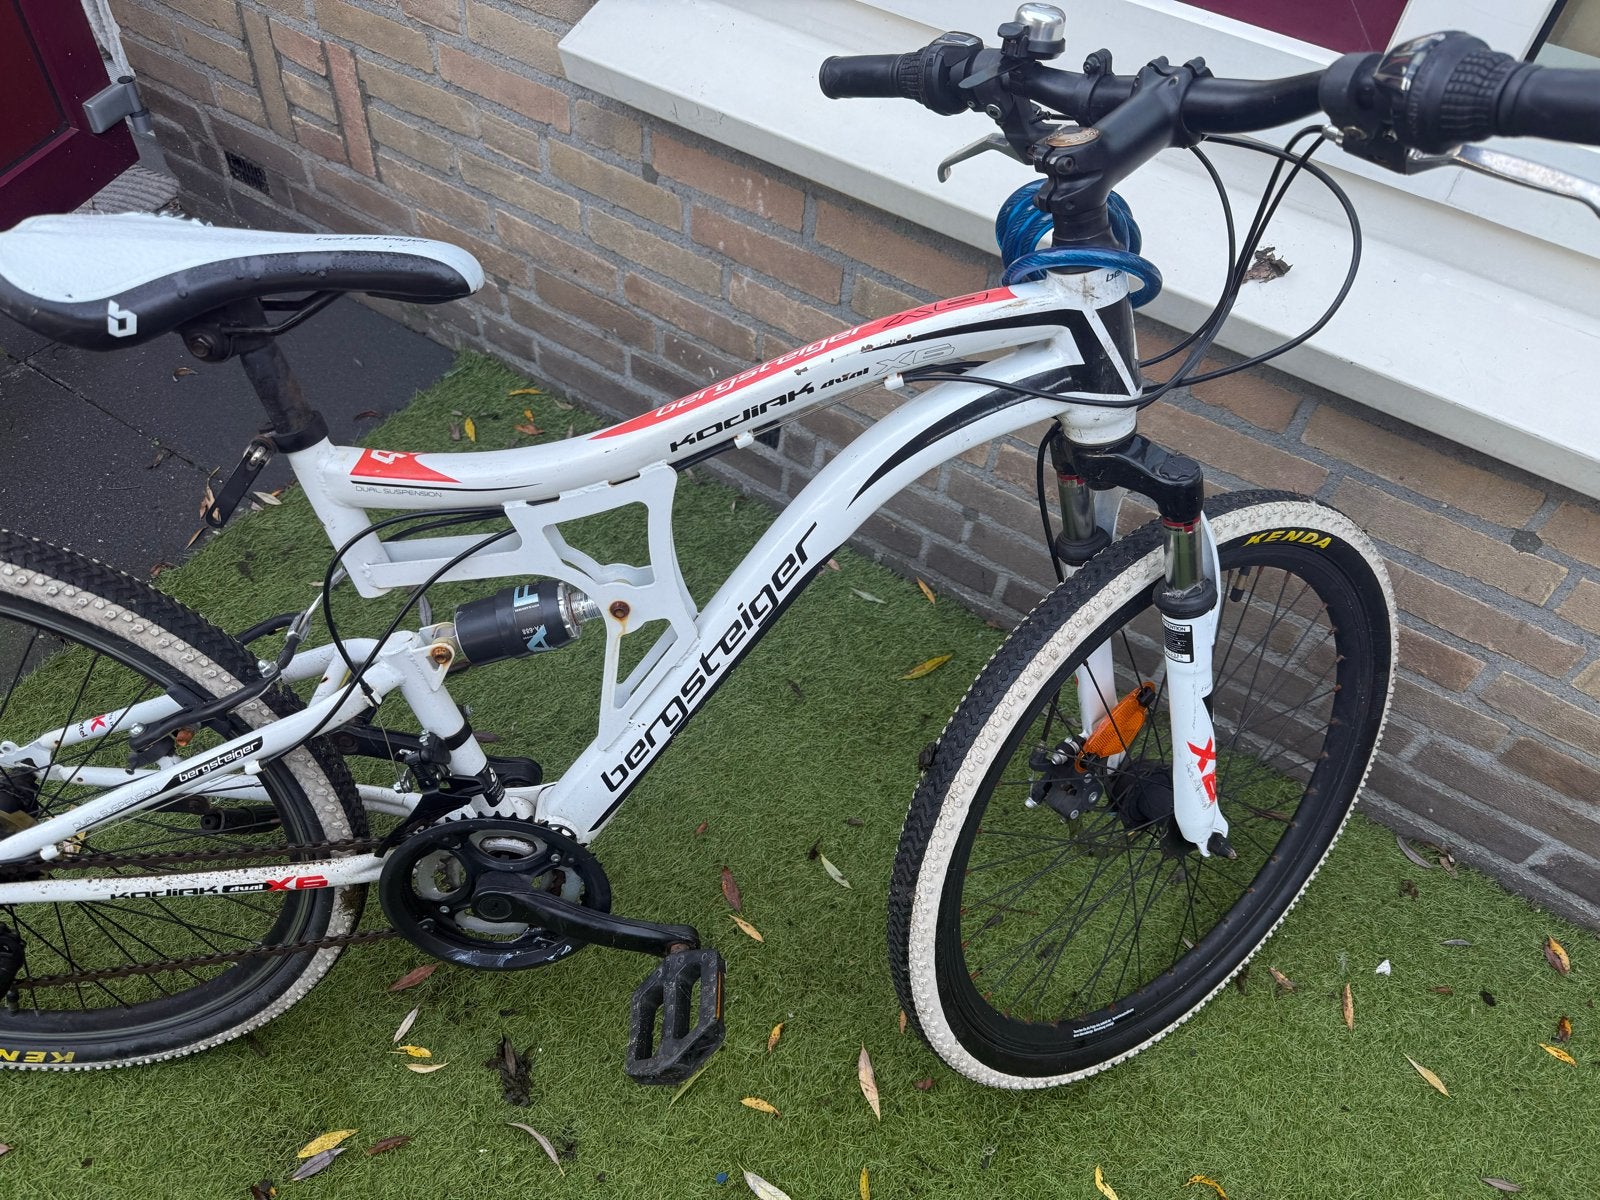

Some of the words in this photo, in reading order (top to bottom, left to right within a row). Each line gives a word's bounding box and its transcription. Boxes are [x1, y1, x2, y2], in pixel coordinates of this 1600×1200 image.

[655, 326, 860, 418] bergsteiger
[355, 485, 382, 494] DUAL
[383, 488, 443, 498] SUSPENSION
[1242, 530, 1332, 549] KENDA
[600, 521, 818, 793] bergsteiger
[178, 741, 259, 783] bergsteiger
[73, 814, 99, 831] DUAL
[100, 785, 161, 818] SUSPENSION
[228, 883, 265, 893] dual
[265, 874, 329, 892] X6
